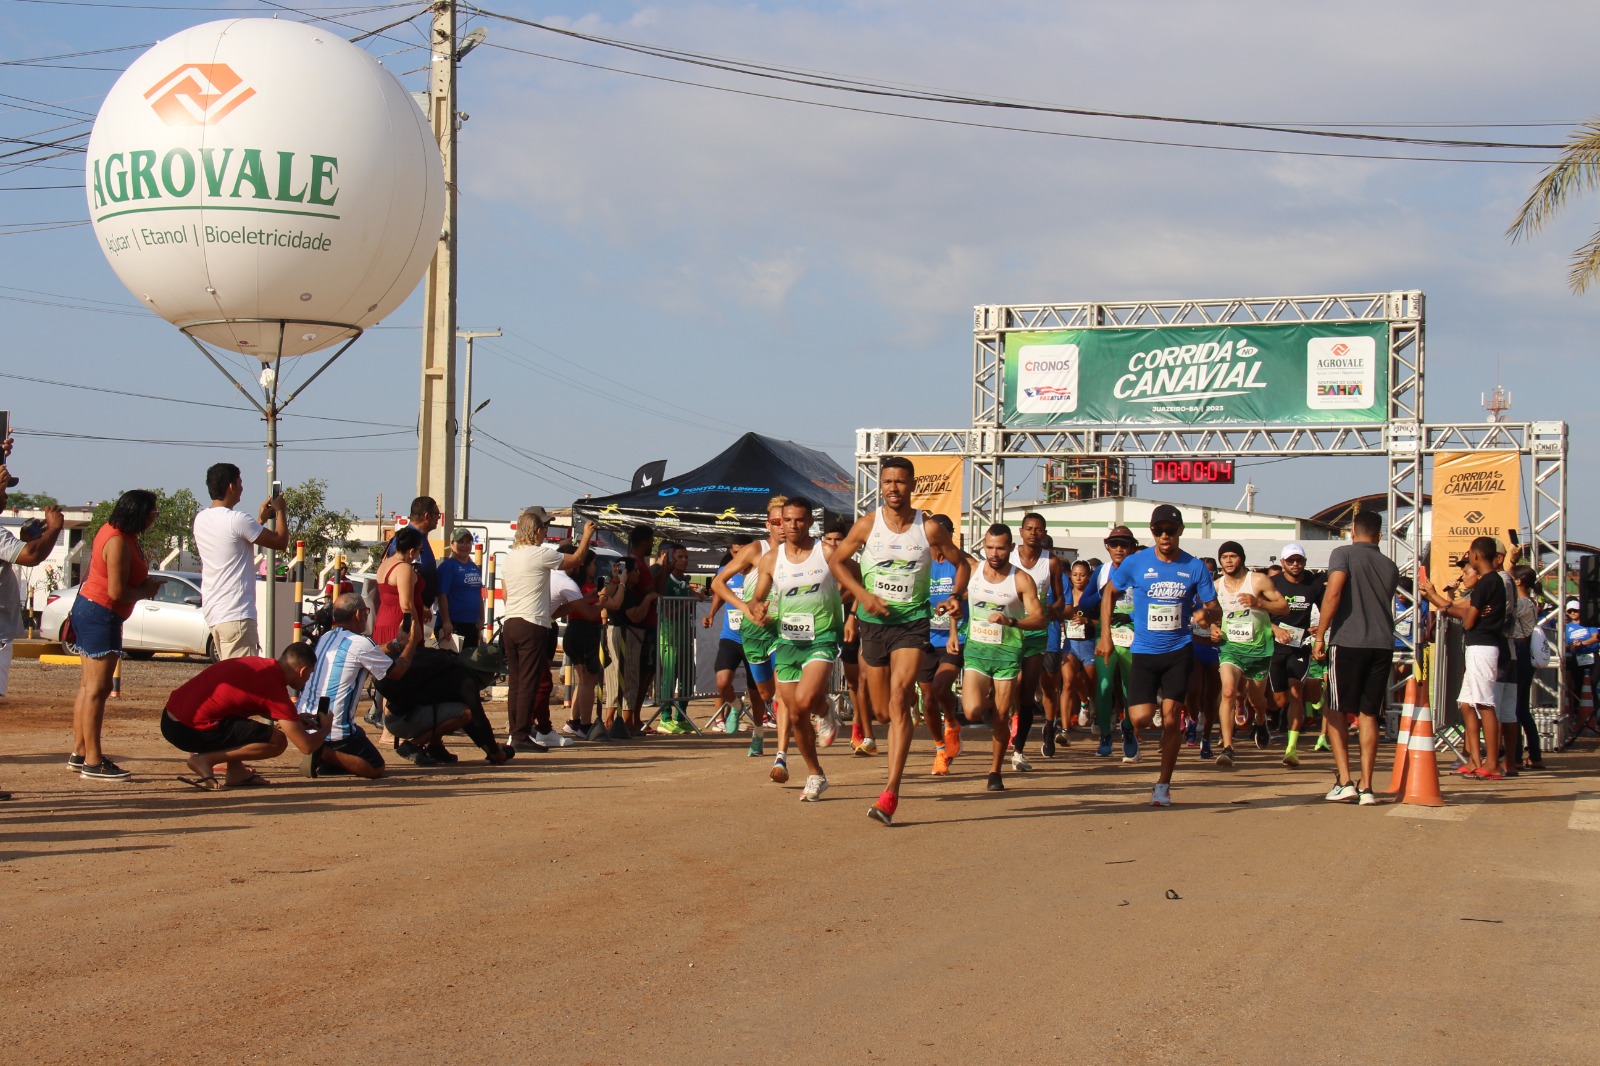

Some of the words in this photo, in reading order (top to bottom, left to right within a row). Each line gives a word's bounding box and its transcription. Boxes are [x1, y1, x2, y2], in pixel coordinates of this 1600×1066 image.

[94, 147, 340, 209] AGROVALE
[141, 225, 188, 246] Etanol
[205, 225, 332, 252] Bioeletricidade
[1128, 341, 1233, 372] CORRIDA
[1025, 360, 1070, 372] CRONOS
[1317, 359, 1364, 368] AGROVALE
[1113, 361, 1267, 399] CANAVIAL
[1317, 384, 1363, 396] BAHIA
[1154, 461, 1231, 481] 00:00:04
[1450, 471, 1493, 483] CORRIDA
[914, 474, 942, 483] ORRIDA
[682, 485, 716, 493] PONTO
[914, 482, 952, 493] NAVIAL
[1444, 480, 1506, 495] CANAVIAL
[1448, 527, 1500, 536] AGROVALE
[878, 581, 909, 593] 50201
[1151, 582, 1180, 590] CORRIDA
[783, 623, 811, 632] 50292
[972, 625, 999, 636] 50408
[1228, 628, 1250, 636] 50036
